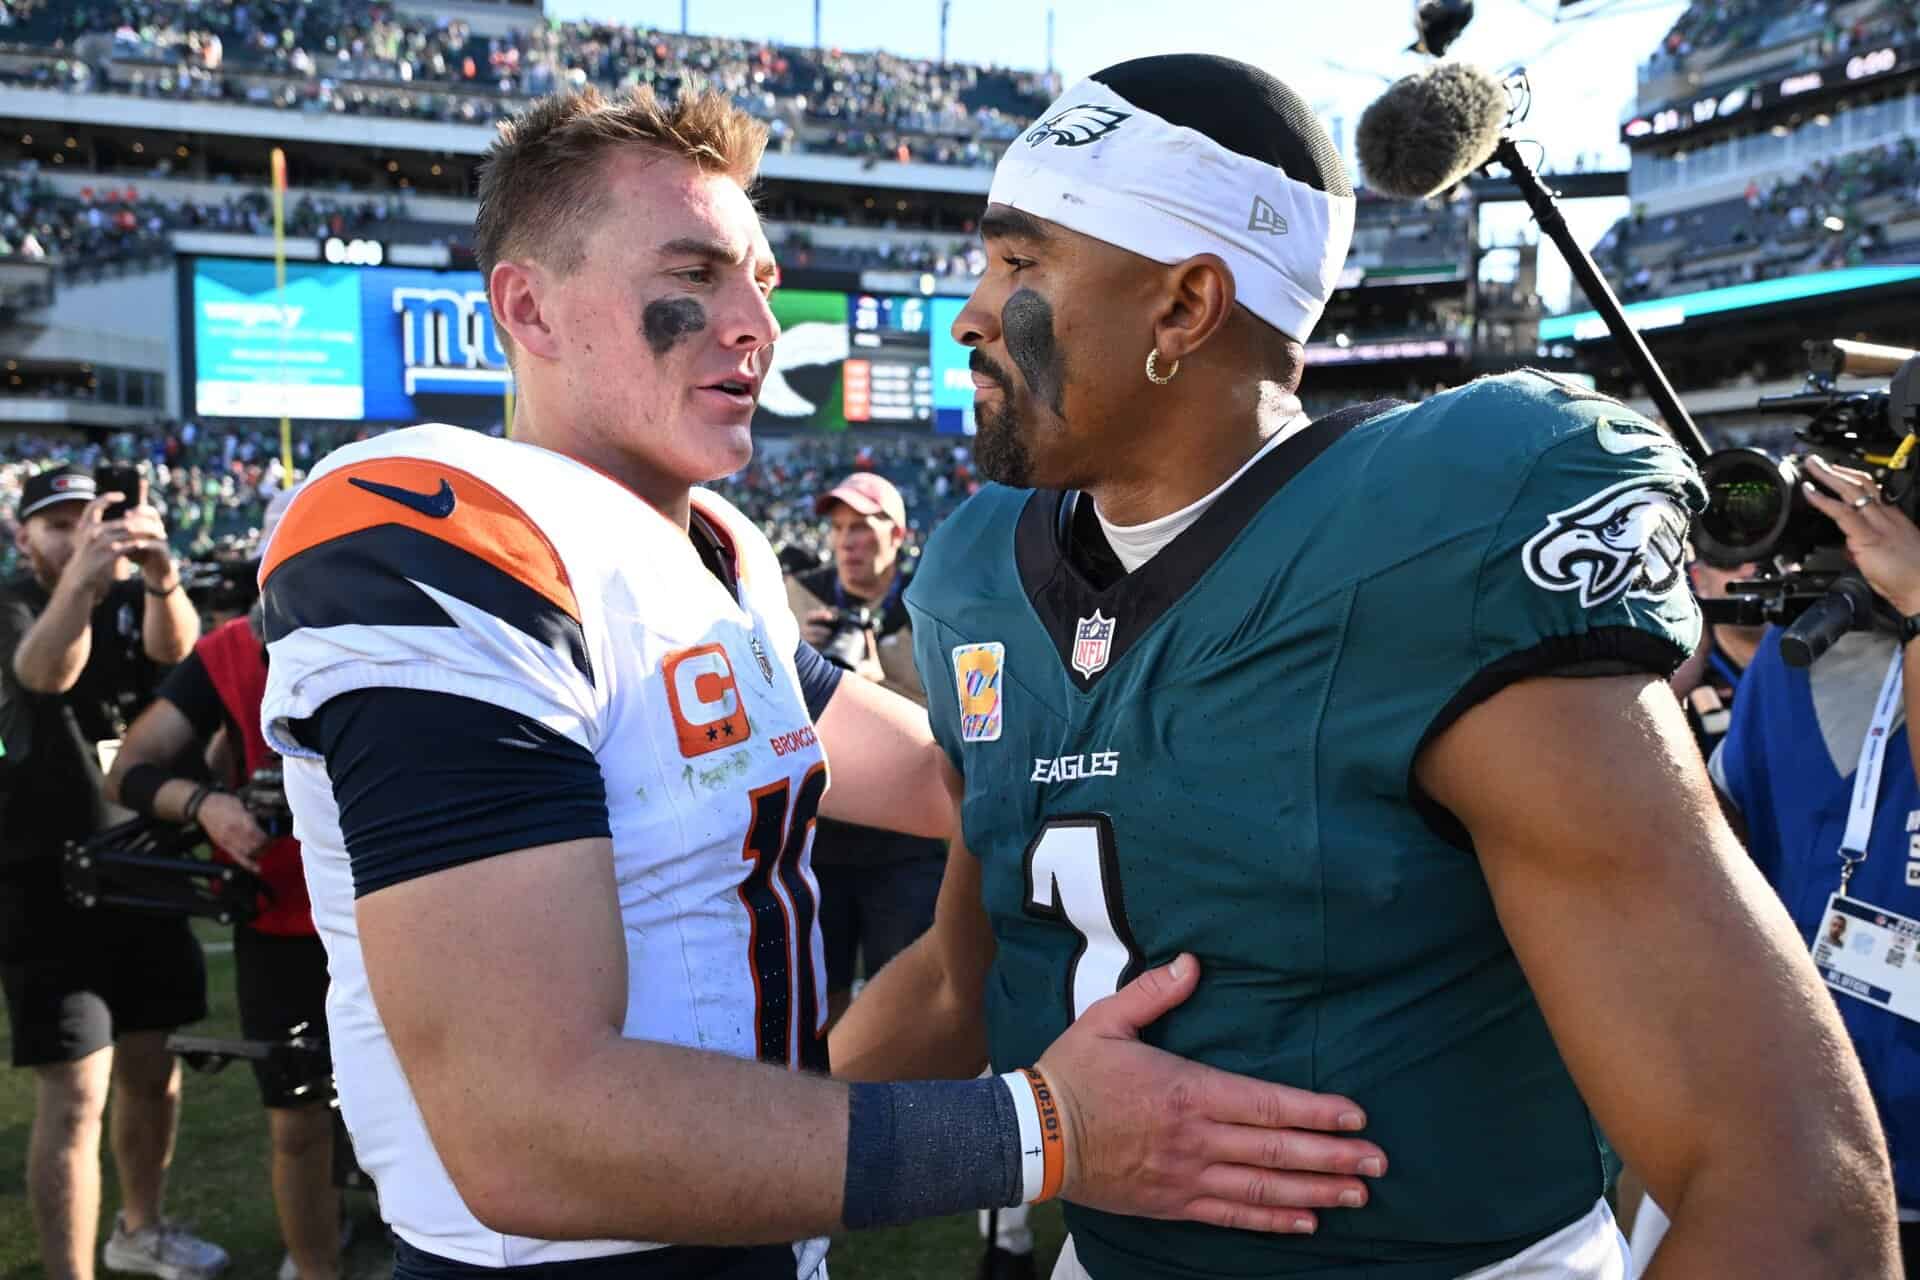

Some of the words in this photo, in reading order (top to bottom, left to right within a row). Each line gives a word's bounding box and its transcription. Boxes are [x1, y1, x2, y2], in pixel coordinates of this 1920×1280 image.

[1078, 641, 1104, 666] NFL
[674, 651, 738, 727] C
[770, 725, 818, 756] BRONCO
[1030, 750, 1120, 784] EAGLES
[1025, 813, 1145, 1024] 1
